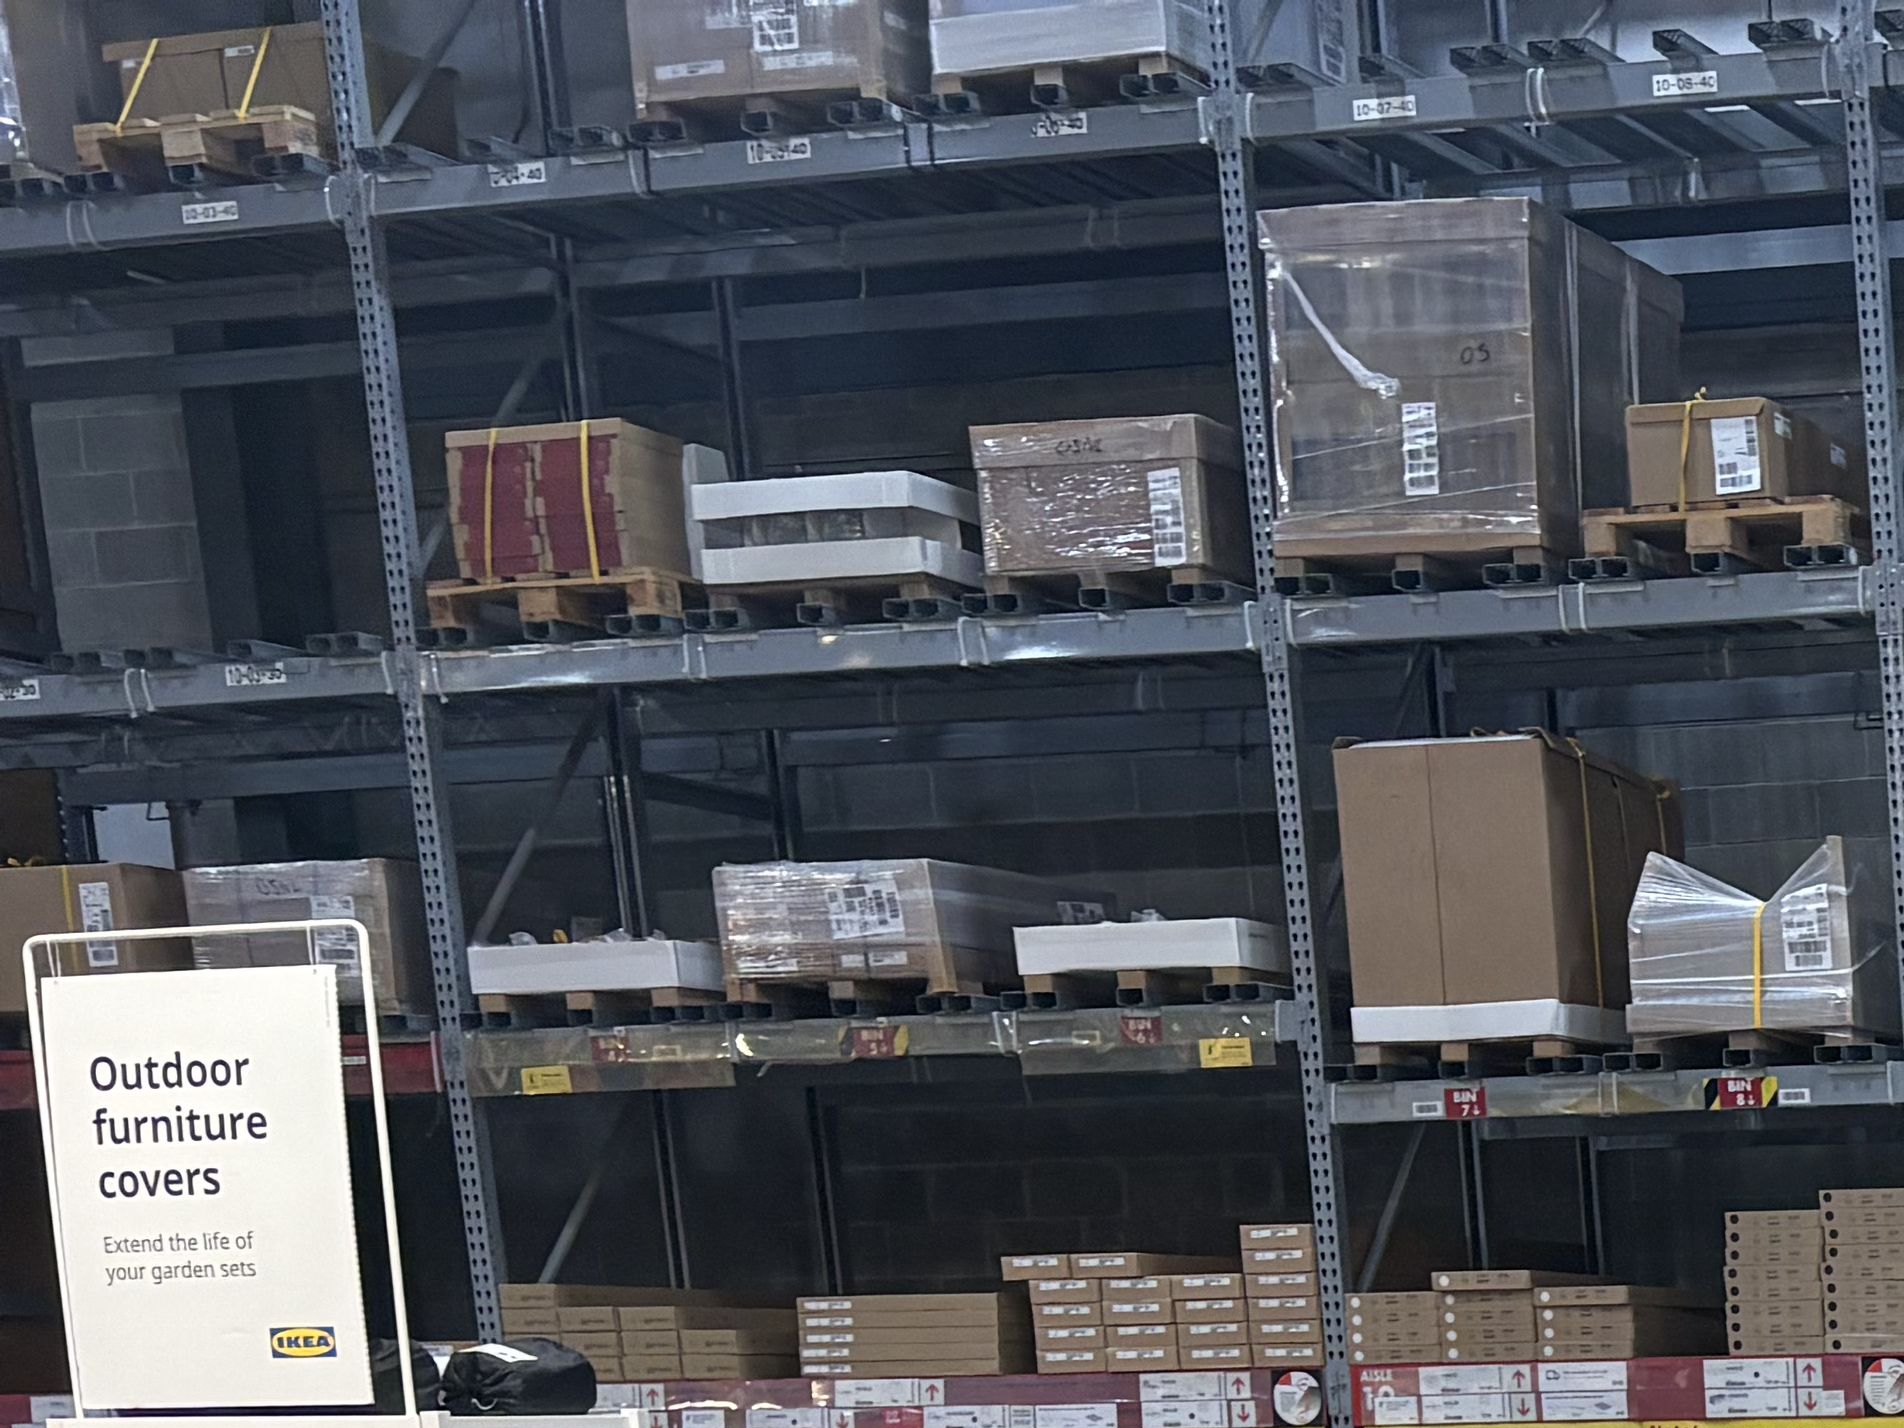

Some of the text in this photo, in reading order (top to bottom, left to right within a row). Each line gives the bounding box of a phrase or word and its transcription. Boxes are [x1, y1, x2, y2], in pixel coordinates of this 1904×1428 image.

[91, 1051, 249, 1091] Outdoor
[1727, 1080, 1752, 1092] BIN
[1453, 1090, 1477, 1103] BIN
[1736, 1093, 1745, 1106] 8
[1462, 1105, 1471, 1116] 7
[93, 1105, 267, 1145] furniture
[99, 1166, 220, 1198] covers
[103, 1231, 254, 1254] Extend the life of
[106, 1261, 256, 1286] your garden sets
[276, 1335, 330, 1349] IKEA
[1360, 1370, 1394, 1381] AISLE
